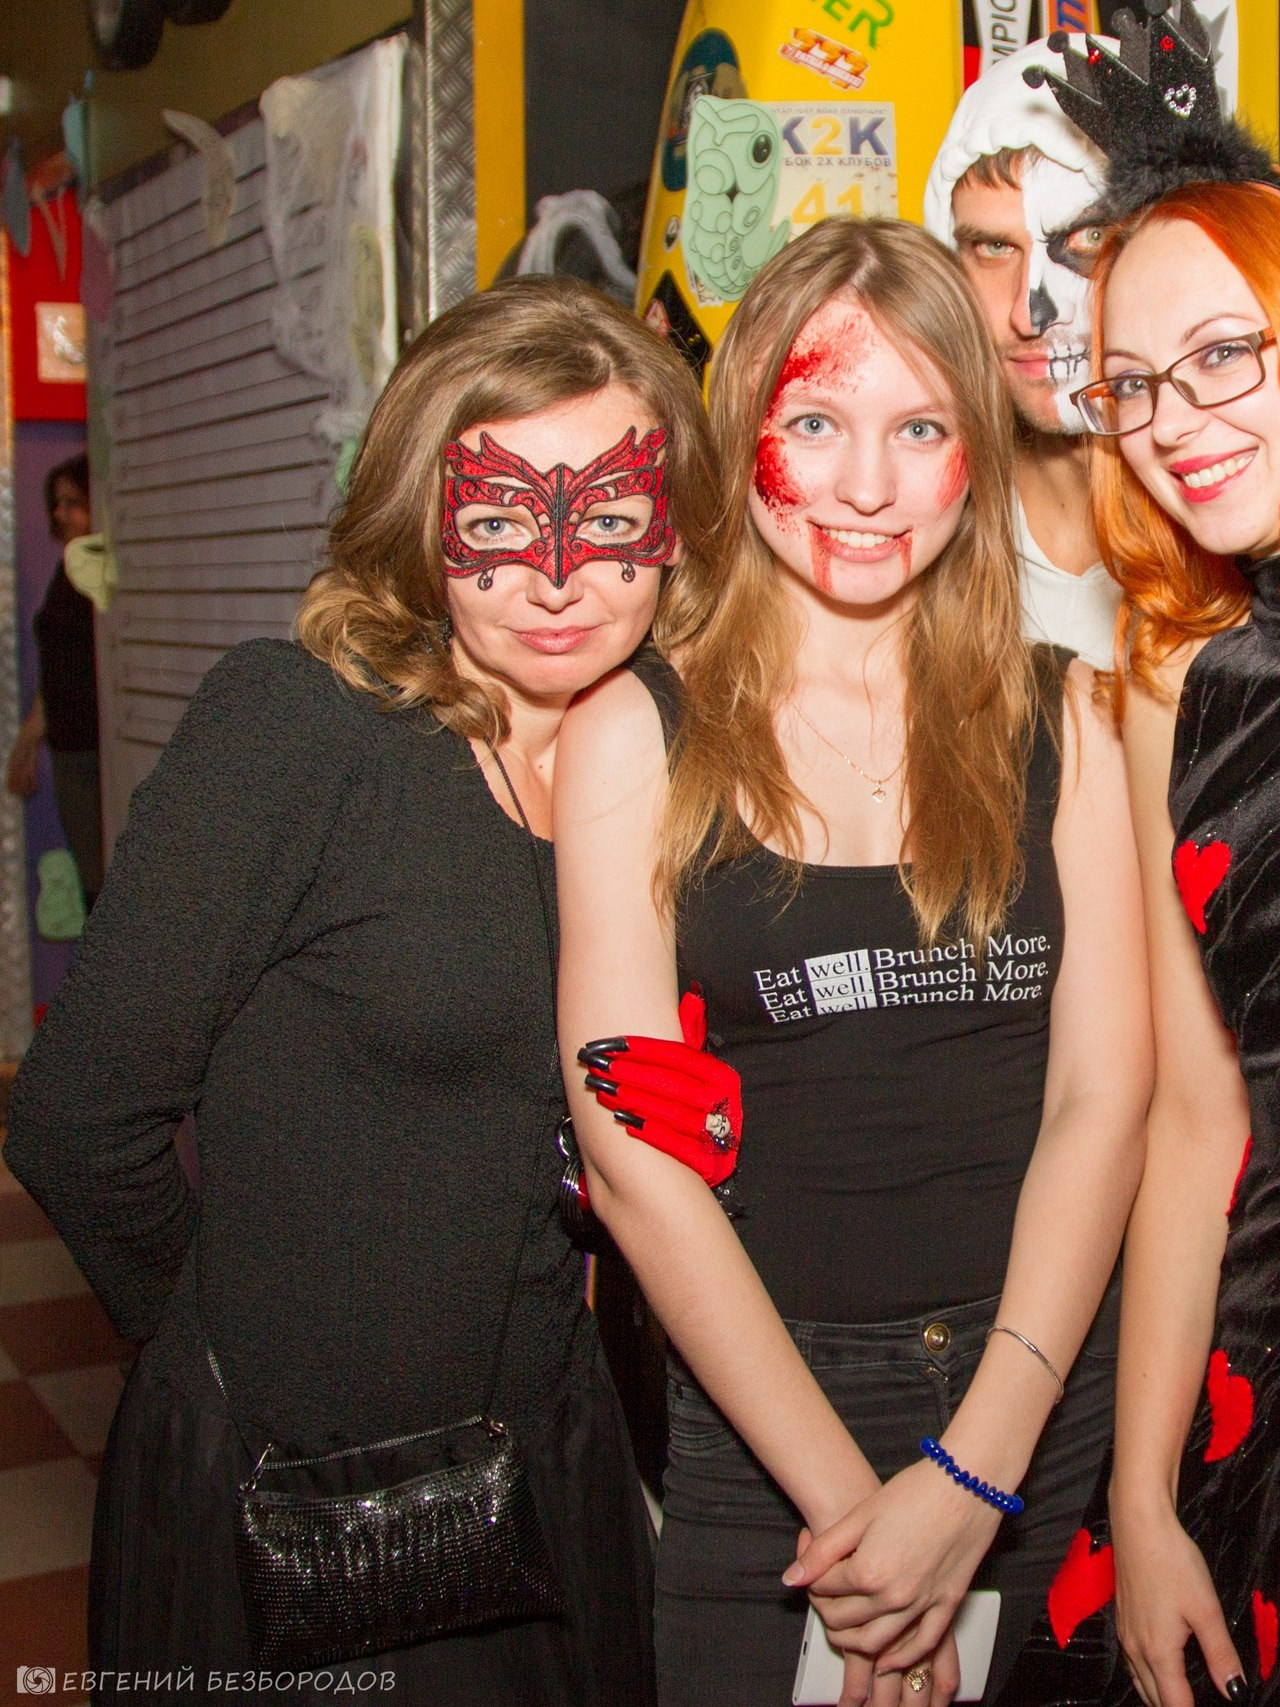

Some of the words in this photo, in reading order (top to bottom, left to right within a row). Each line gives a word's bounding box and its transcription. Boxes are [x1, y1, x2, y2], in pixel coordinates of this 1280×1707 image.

[822, 0, 894, 49] ER
[784, 156, 813, 167] БОК
[838, 156, 892, 167] КЛУБОВ
[753, 966, 803, 991] Eat
[809, 951, 869, 978] well.
[873, 938, 976, 970] Brunch
[987, 934, 1051, 957] More.
[760, 988, 808, 1010] Eat
[815, 975, 873, 999] well.
[876, 962, 978, 991] Brunch
[986, 960, 1049, 982] More.
[768, 1005, 813, 1024] Eat
[880, 984, 974, 1007] Brunch
[983, 982, 1042, 1002] More.
